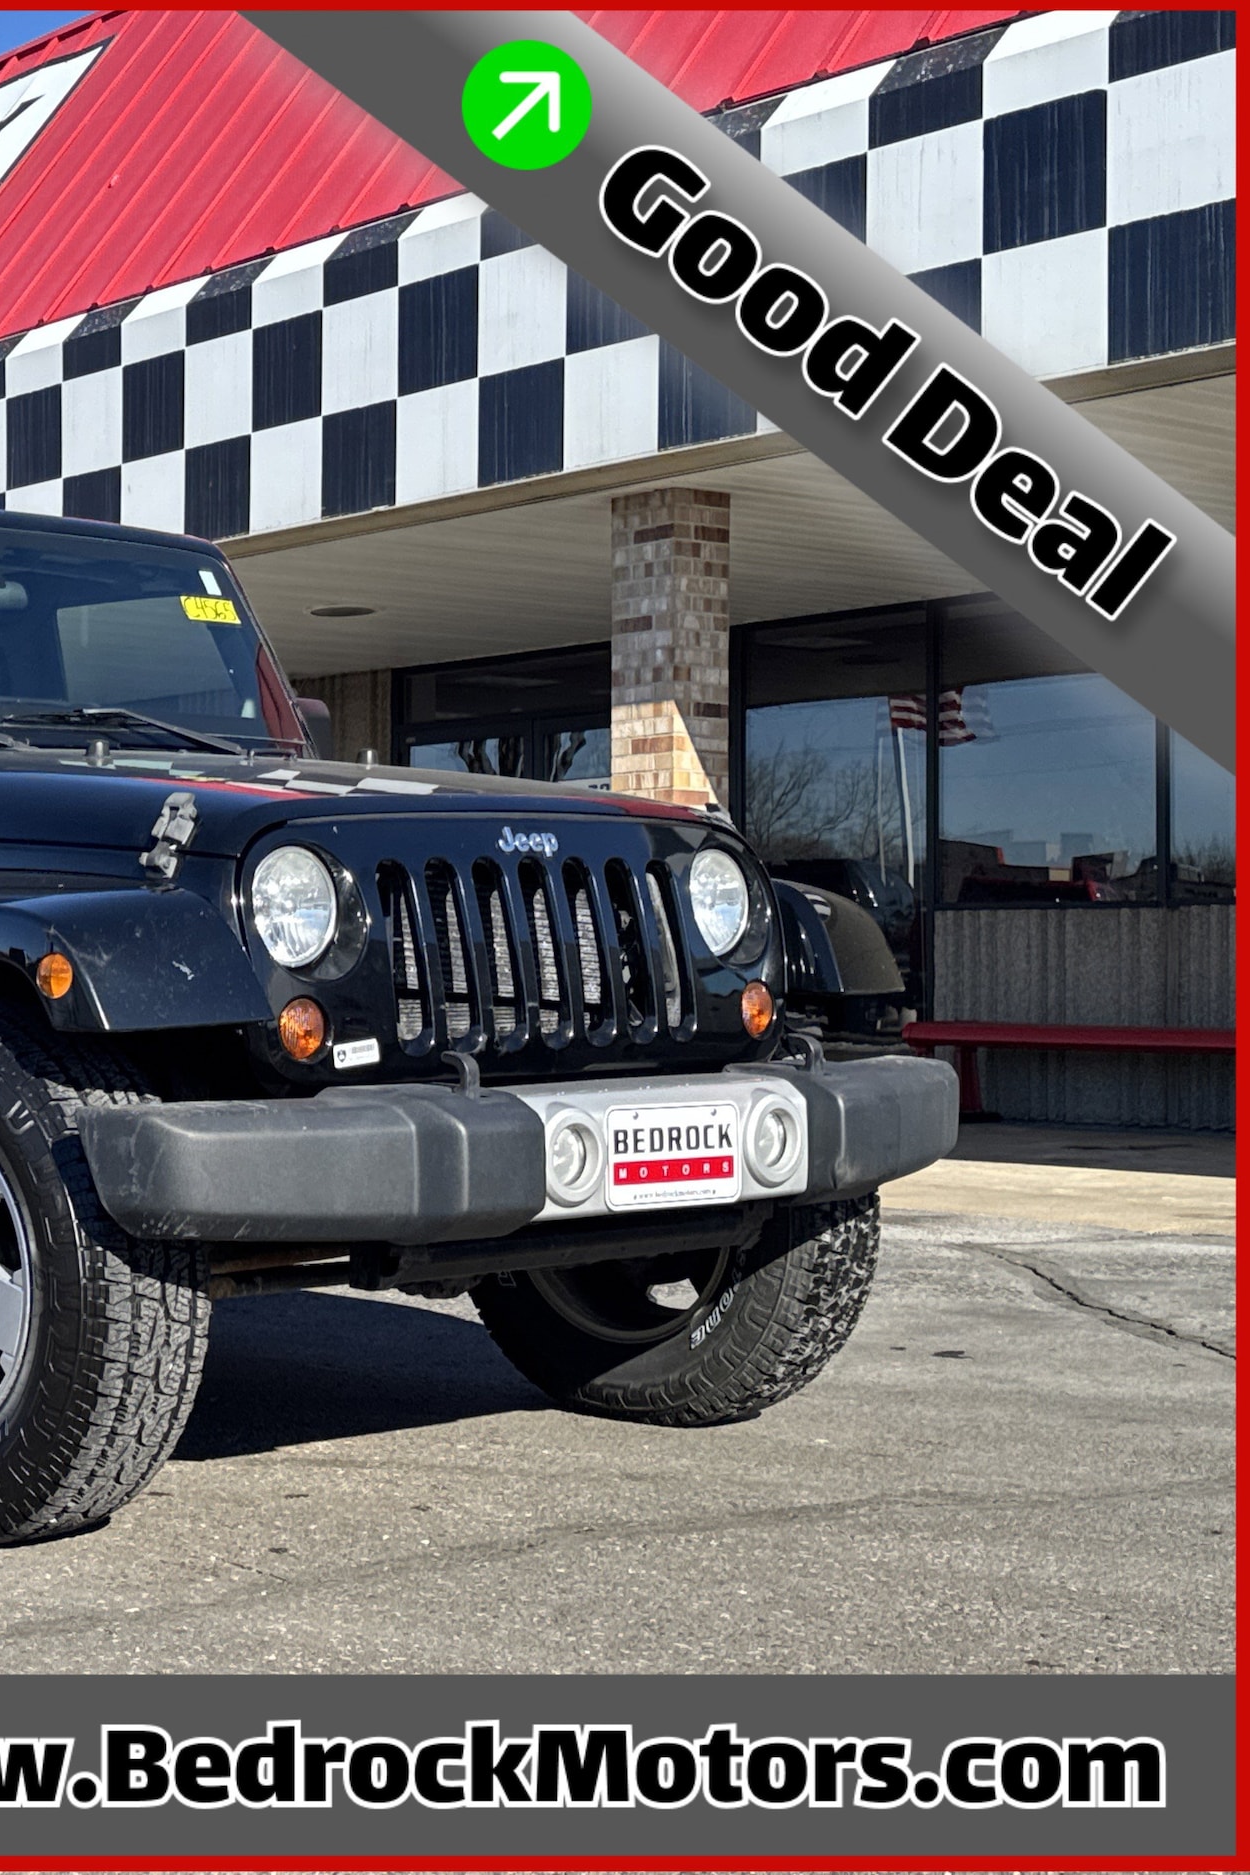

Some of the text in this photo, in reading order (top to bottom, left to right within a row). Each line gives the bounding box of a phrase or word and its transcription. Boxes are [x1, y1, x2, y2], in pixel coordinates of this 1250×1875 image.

[497, 825, 559, 858] Jeep
[613, 1123, 733, 1155] BEDROCK
[618, 1161, 730, 1180] MOTORS
